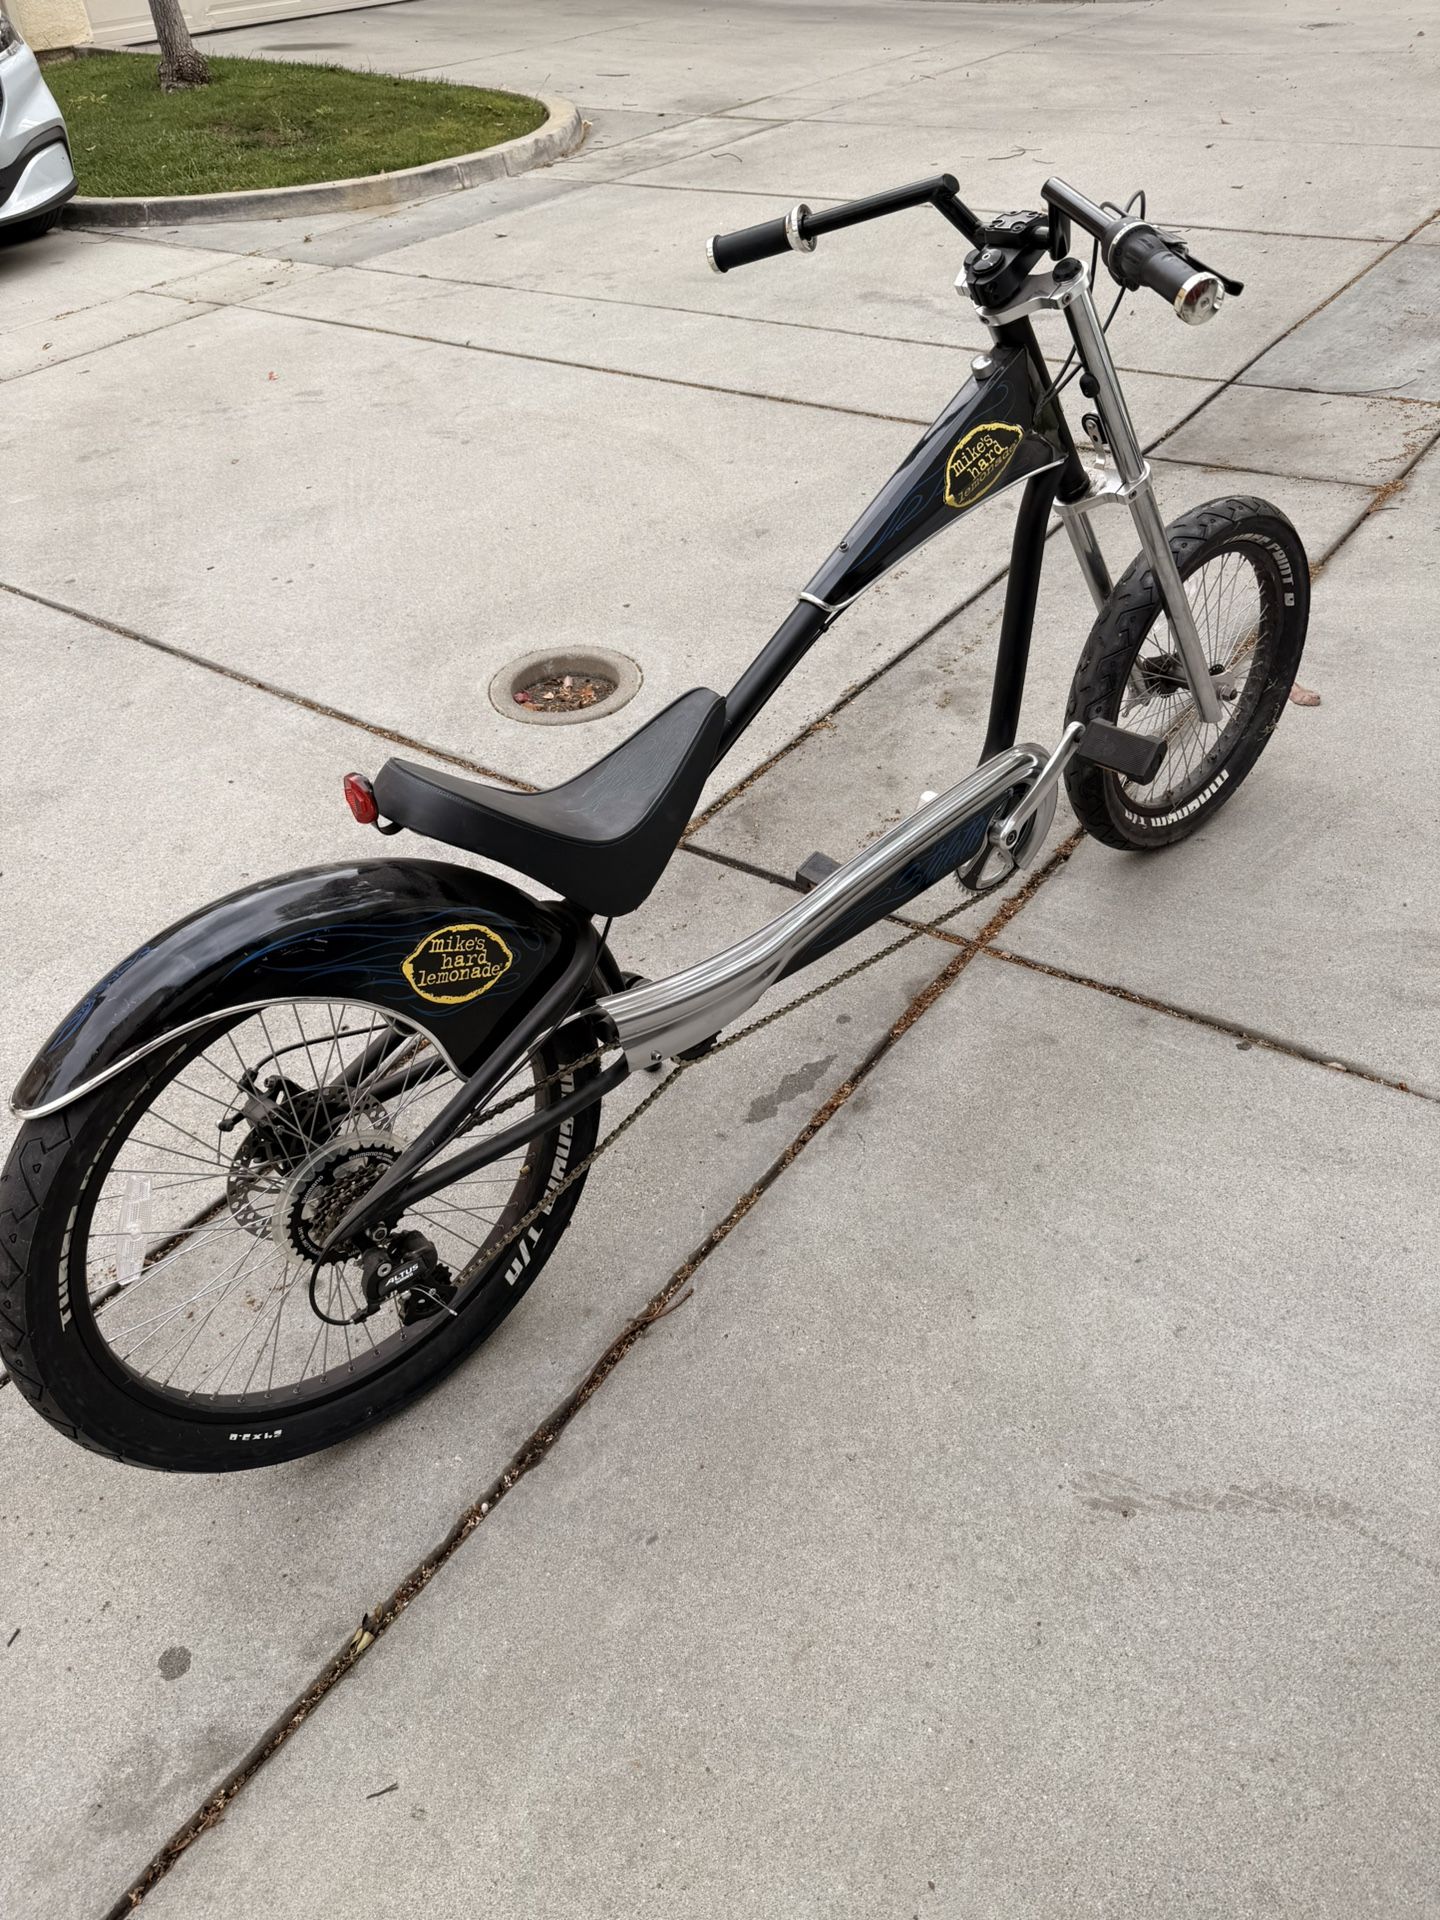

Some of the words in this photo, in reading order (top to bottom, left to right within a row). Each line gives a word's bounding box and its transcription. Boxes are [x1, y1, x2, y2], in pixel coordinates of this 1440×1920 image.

[950, 433, 994, 477] mike's
[967, 440, 1009, 480] hard
[428, 935, 487, 953] mike's
[440, 948, 488, 970] hard
[385, 1263, 419, 1287] ALTUS
